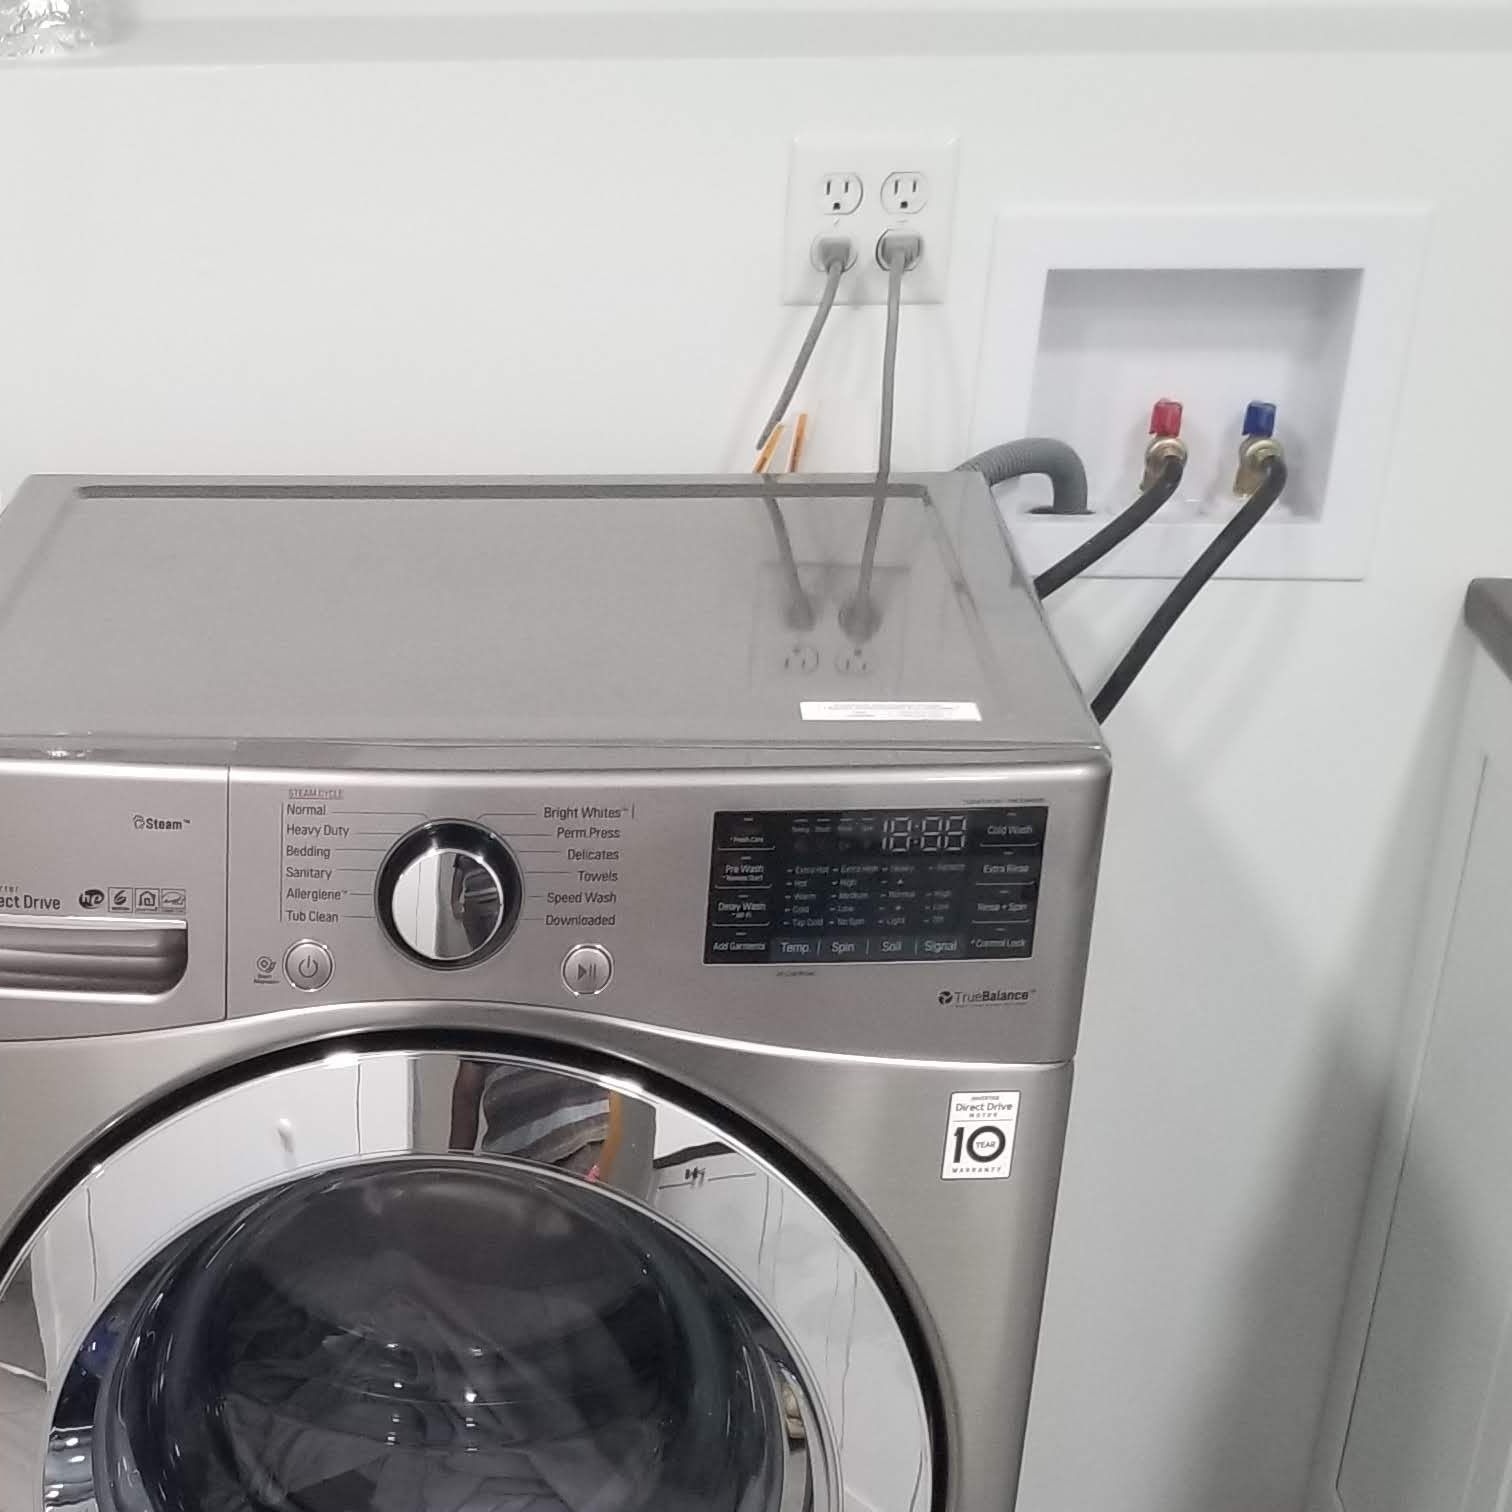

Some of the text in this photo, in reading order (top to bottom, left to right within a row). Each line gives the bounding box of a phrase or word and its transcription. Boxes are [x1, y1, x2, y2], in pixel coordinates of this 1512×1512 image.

[286, 804, 326, 815] Normal
[544, 806, 578, 820] Bright
[286, 825, 349, 838] Heavy Duty
[589, 828, 620, 839] Press
[286, 846, 330, 859] Bedding
[568, 849, 619, 860] Delicates
[286, 868, 332, 880] Sanitary
[742, 864, 764, 873] Wash
[578, 870, 618, 881] Towels
[24, 894, 60, 909] Drive
[547, 892, 616, 905] Speed Wash
[286, 911, 338, 923] Tub Clean
[546, 914, 615, 926] Downloaded
[832, 941, 855, 953] Spin
[882, 941, 902, 951] Soil
[925, 941, 957, 952] Signal
[956, 1103, 1012, 1111] Direct Drive
[953, 1126, 1006, 1163] 10
